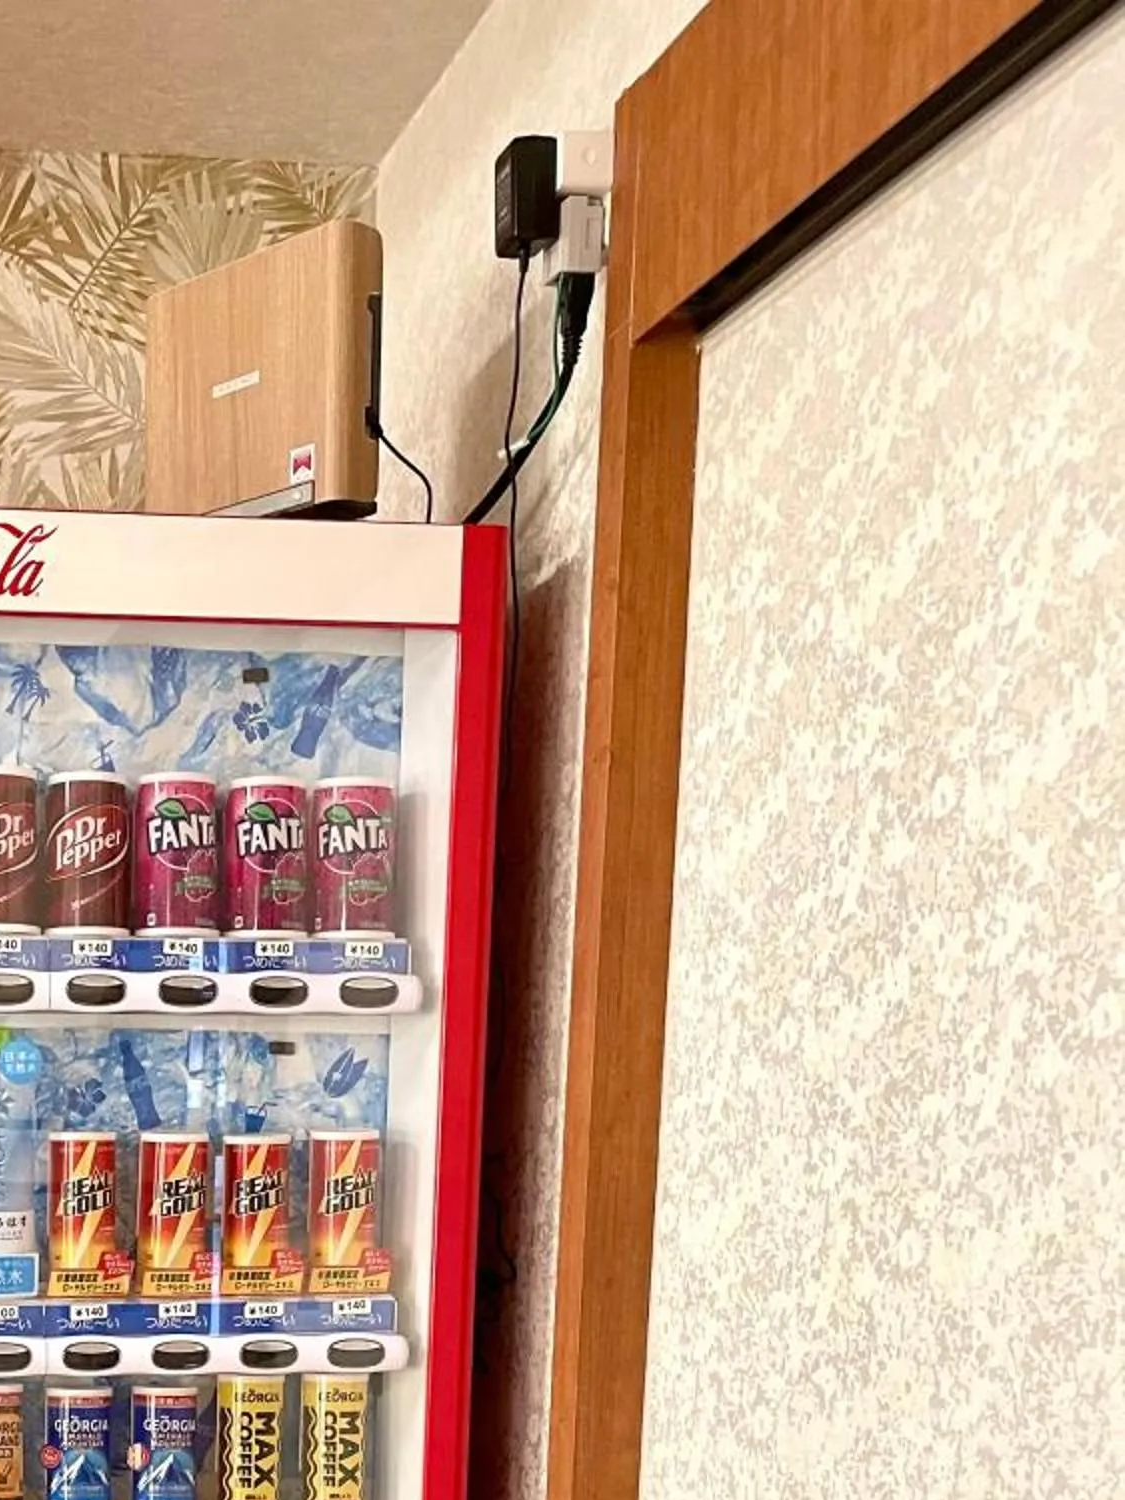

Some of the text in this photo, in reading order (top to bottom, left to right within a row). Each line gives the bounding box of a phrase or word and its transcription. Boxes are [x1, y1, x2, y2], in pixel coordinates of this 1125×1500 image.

[76, 816, 107, 837] Dr
[319, 818, 388, 858] FANTA
[55, 828, 122, 872] Pepper
[79, 943, 107, 953] ¥140
[169, 943, 198, 953] ¥140
[260, 944, 289, 953] ¥140
[350, 944, 380, 955] ¥140
[75, 1306, 104, 1317] ¥140
[164, 1304, 192, 1314] ¥140
[249, 1305, 278, 1315] ¥140
[338, 1300, 366, 1311] ¥140
[54, 1415, 108, 1433] GEORGIA
[237, 1411, 254, 1488] COFFEE
[254, 1411, 277, 1488] MAX
[323, 1411, 338, 1487] COFFEE
[338, 1411, 361, 1488] MAX
